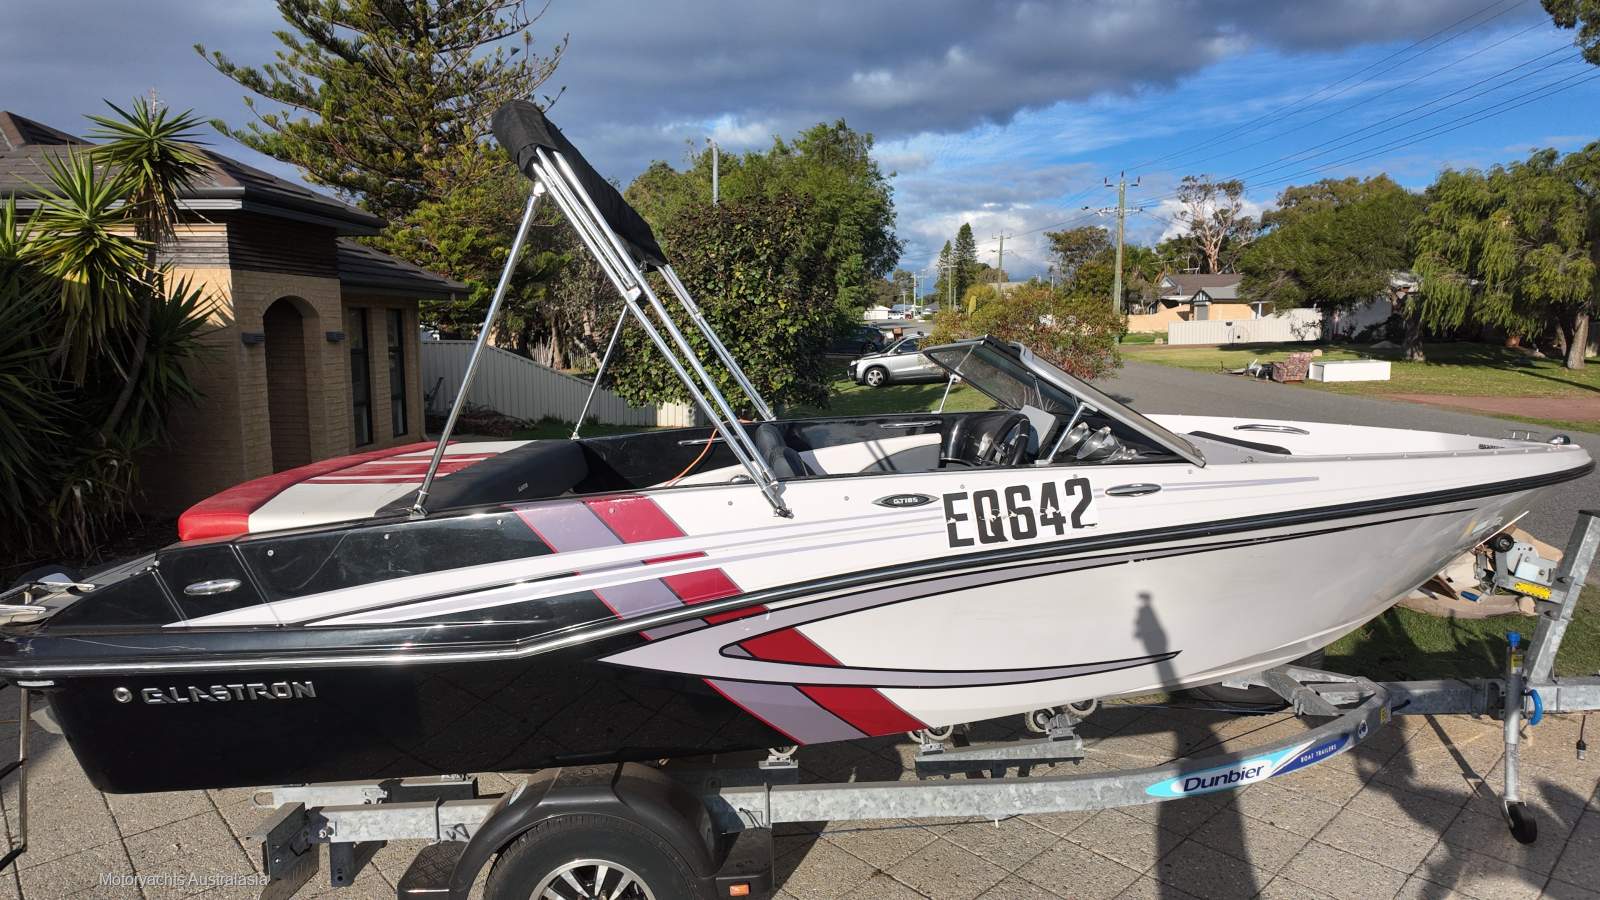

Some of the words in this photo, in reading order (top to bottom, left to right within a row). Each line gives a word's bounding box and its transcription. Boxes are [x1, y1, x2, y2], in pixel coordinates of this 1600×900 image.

[942, 477, 1098, 549] EQ642
[140, 681, 317, 704] GLASTRON
[1183, 764, 1265, 792] Dunbier
